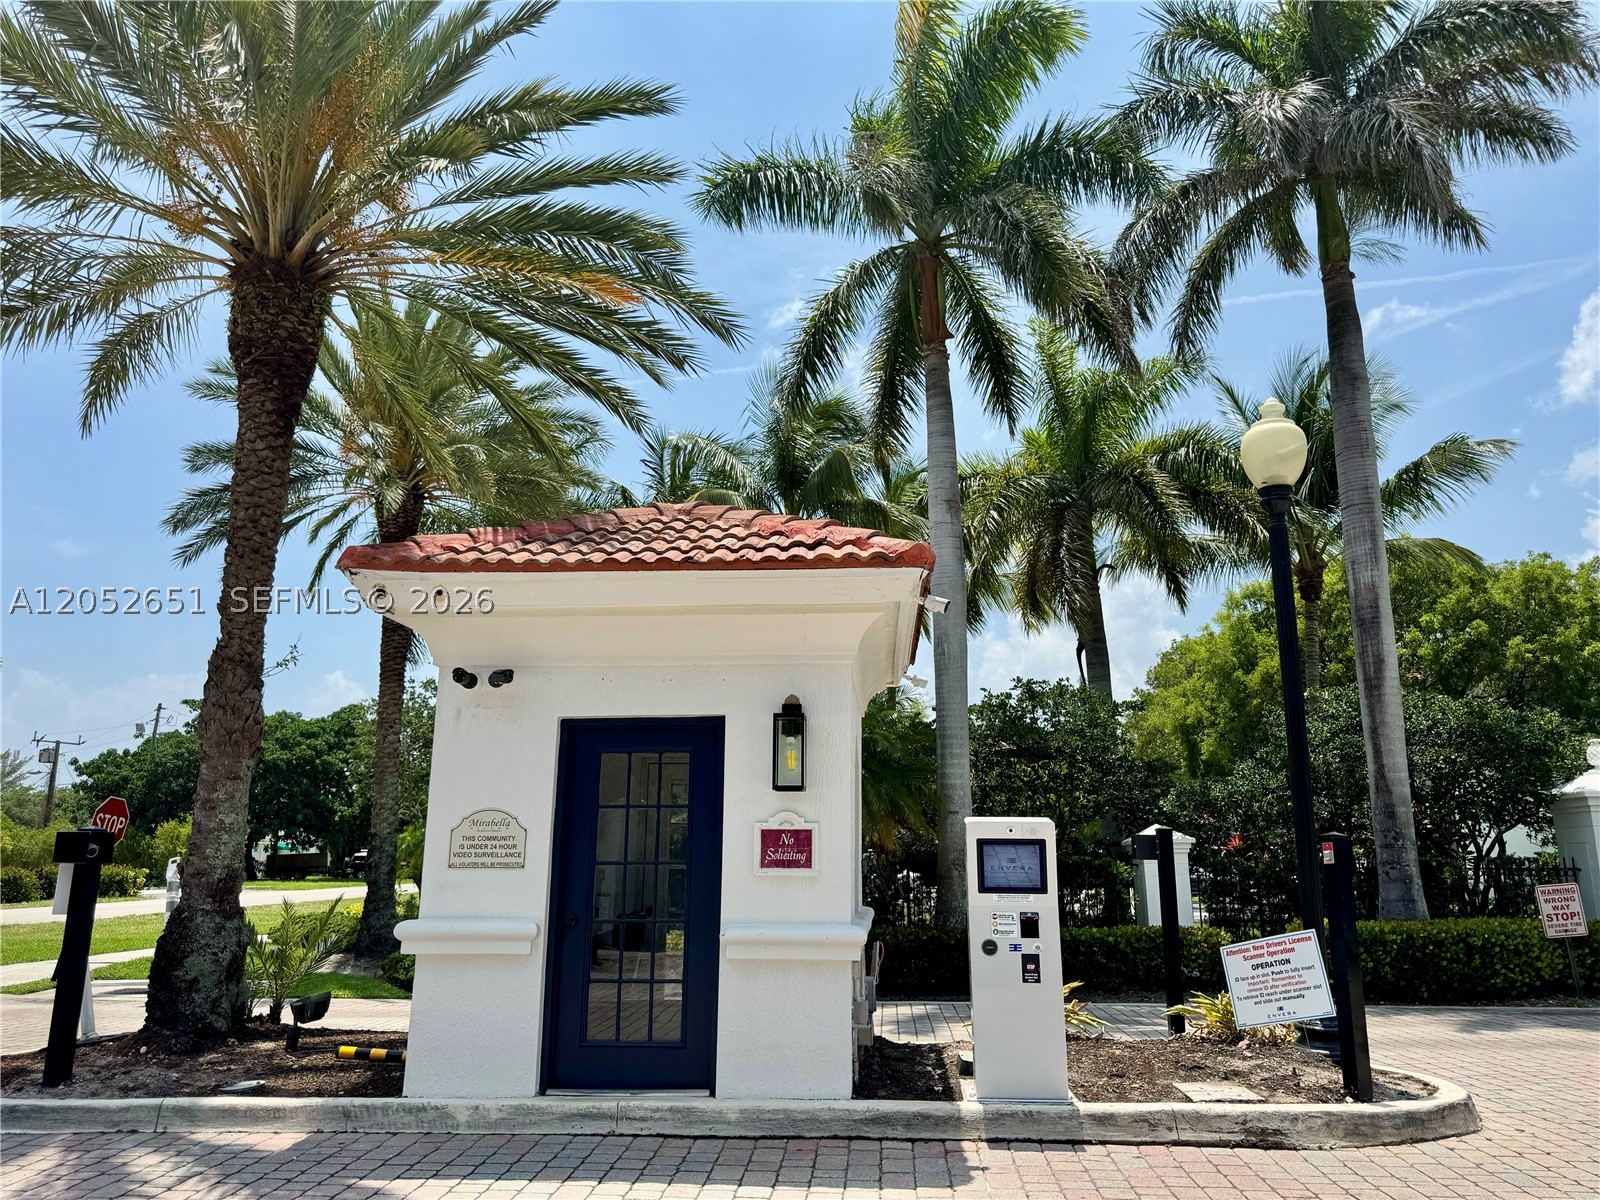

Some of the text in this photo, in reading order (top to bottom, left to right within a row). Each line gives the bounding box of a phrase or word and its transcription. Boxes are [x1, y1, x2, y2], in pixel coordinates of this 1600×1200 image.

[96, 813, 125, 834] STOP
[469, 818, 510, 827] Mirabella
[779, 833, 794, 844] No
[765, 848, 806, 863] Soliciting
[1540, 887, 1576, 895] WARNING
[1546, 912, 1580, 922] STOP!
[1226, 948, 1251, 956] Attention:
[1266, 940, 1287, 948] Drivers
[1289, 935, 1312, 944] License
[1267, 947, 1295, 957] Operation
[1251, 958, 1291, 970] OPERATION
[1281, 980, 1306, 989] verification
